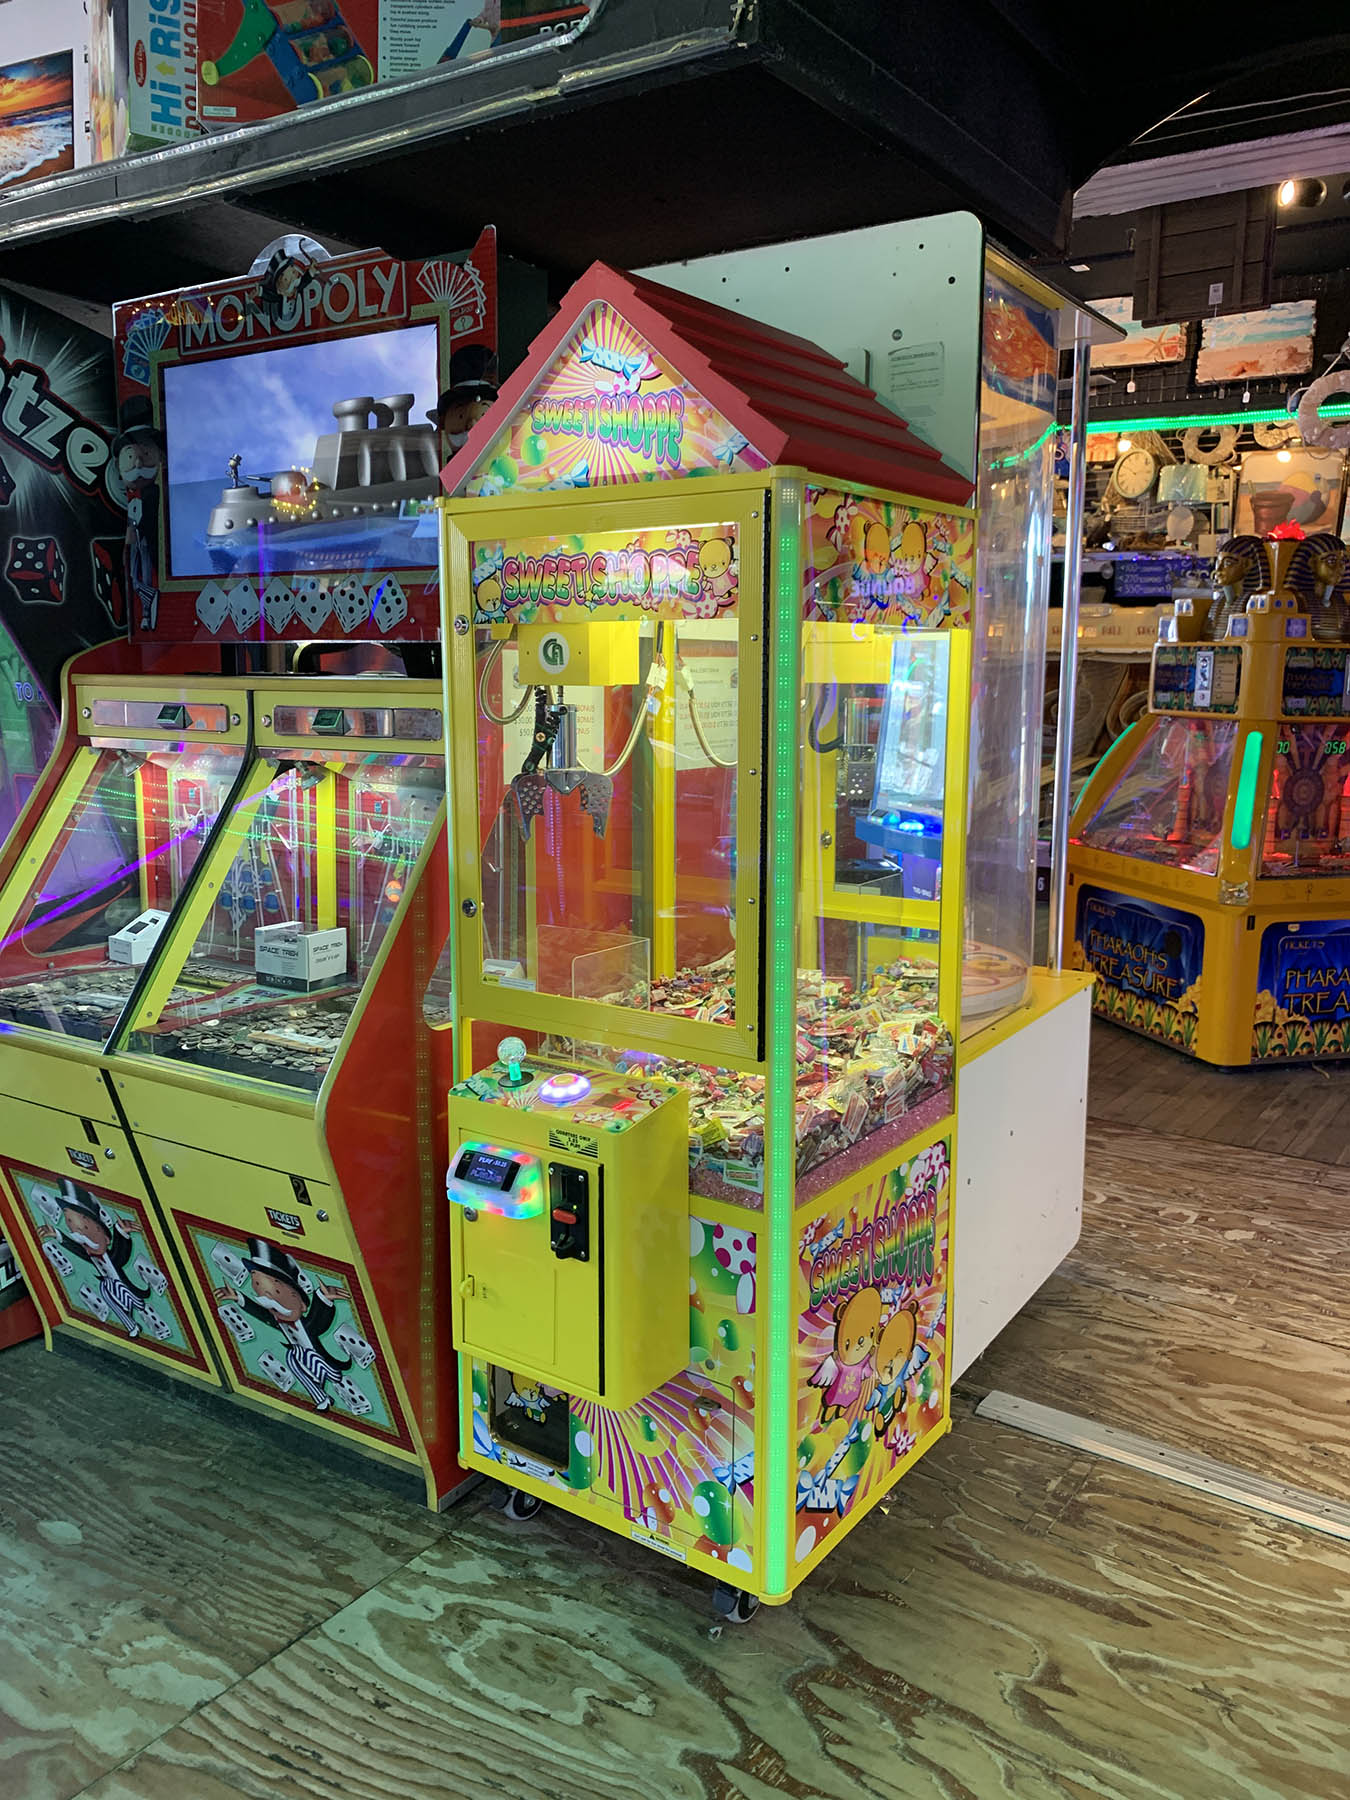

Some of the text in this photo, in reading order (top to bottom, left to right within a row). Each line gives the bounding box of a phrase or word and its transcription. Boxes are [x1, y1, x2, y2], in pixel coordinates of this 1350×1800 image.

[183, 262, 400, 348] MONOPOLY
[532, 389, 684, 468] SWEET SHOPPE
[502, 548, 704, 606] SWEET SHOPPE
[1089, 950, 1180, 1003] TREASURE
[268, 1209, 300, 1225] TICKETS
[810, 1185, 936, 1313] SWEET SHOPPE
